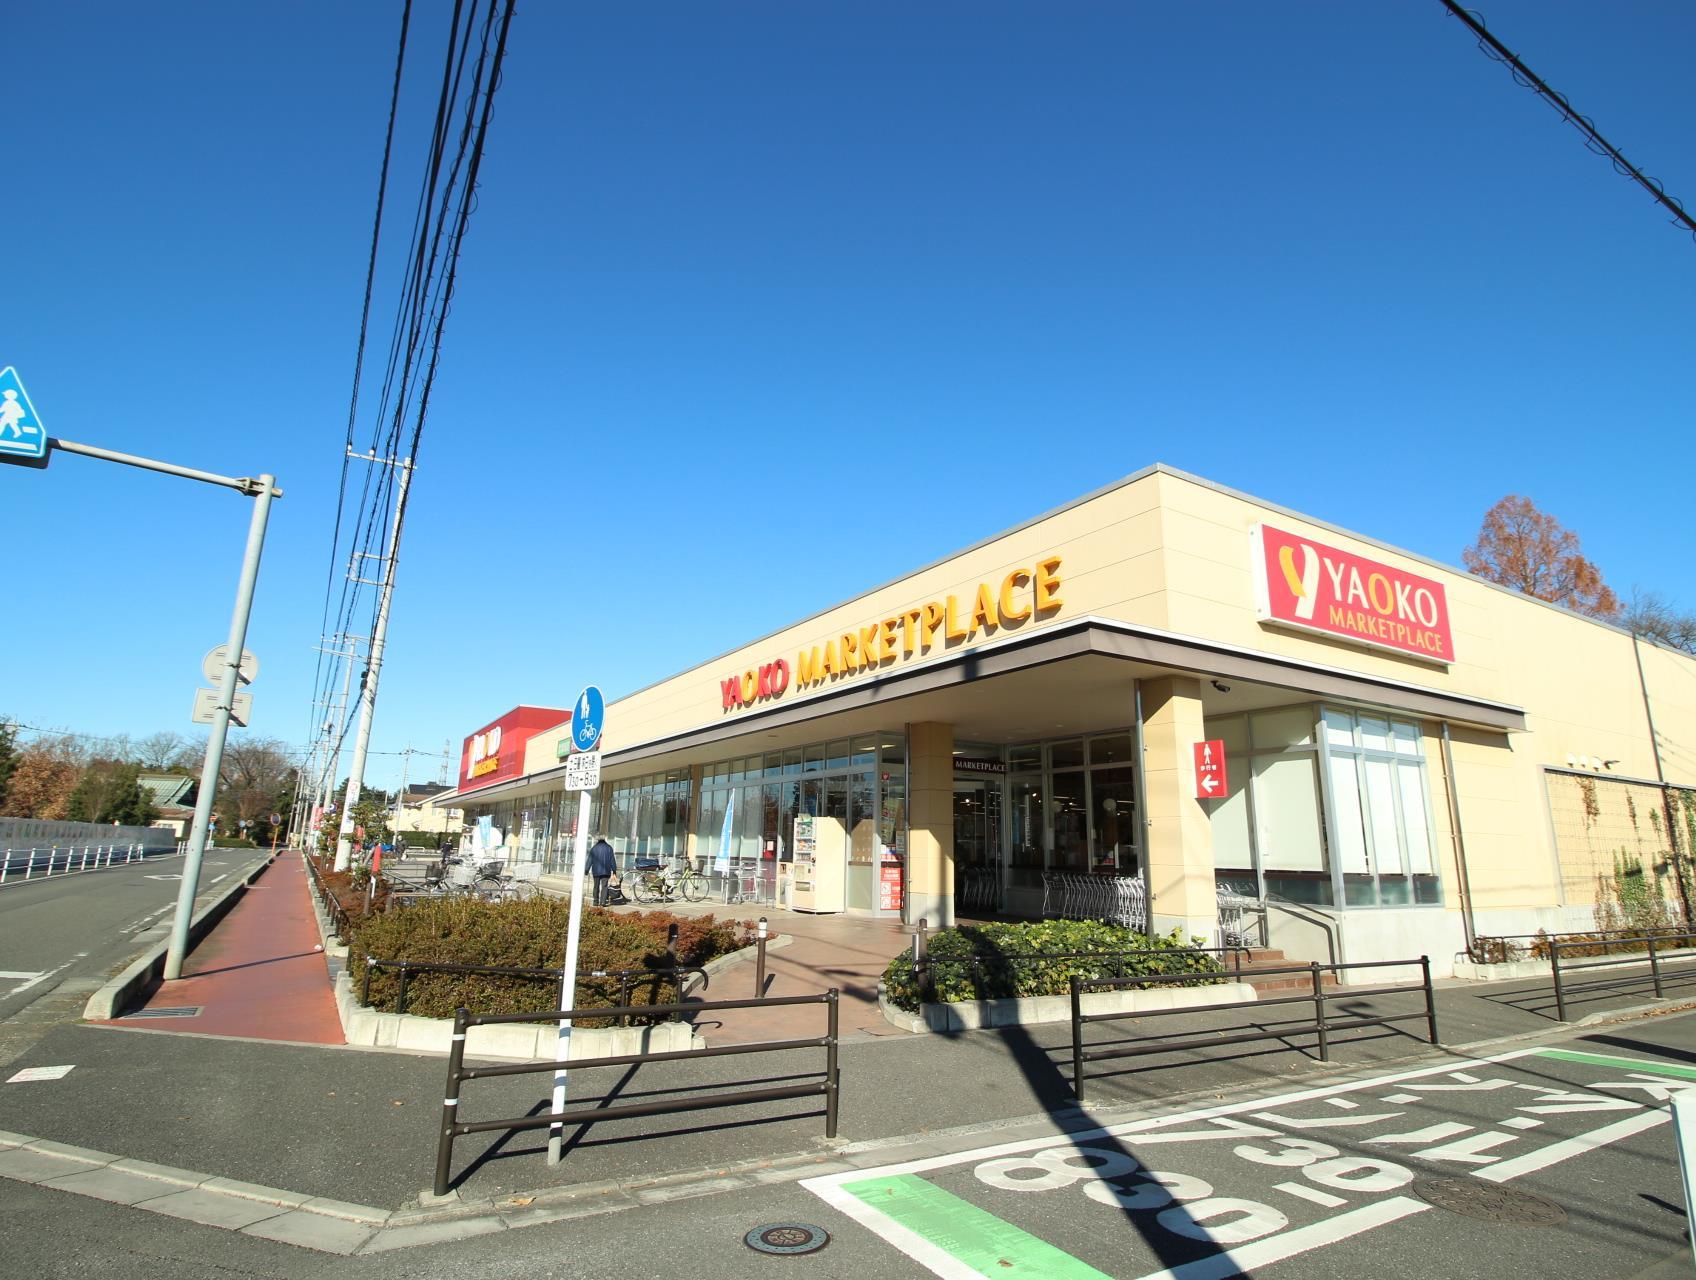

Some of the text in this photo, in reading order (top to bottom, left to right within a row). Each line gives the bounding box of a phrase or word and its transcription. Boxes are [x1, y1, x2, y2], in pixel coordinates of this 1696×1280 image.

[1323, 557, 1438, 628] YAOKO
[720, 555, 1064, 709] YAOKO MARKETPLACE
[1329, 605, 1443, 653] MARKETPLACE
[955, 760, 1005, 772] MARKETPLACE
